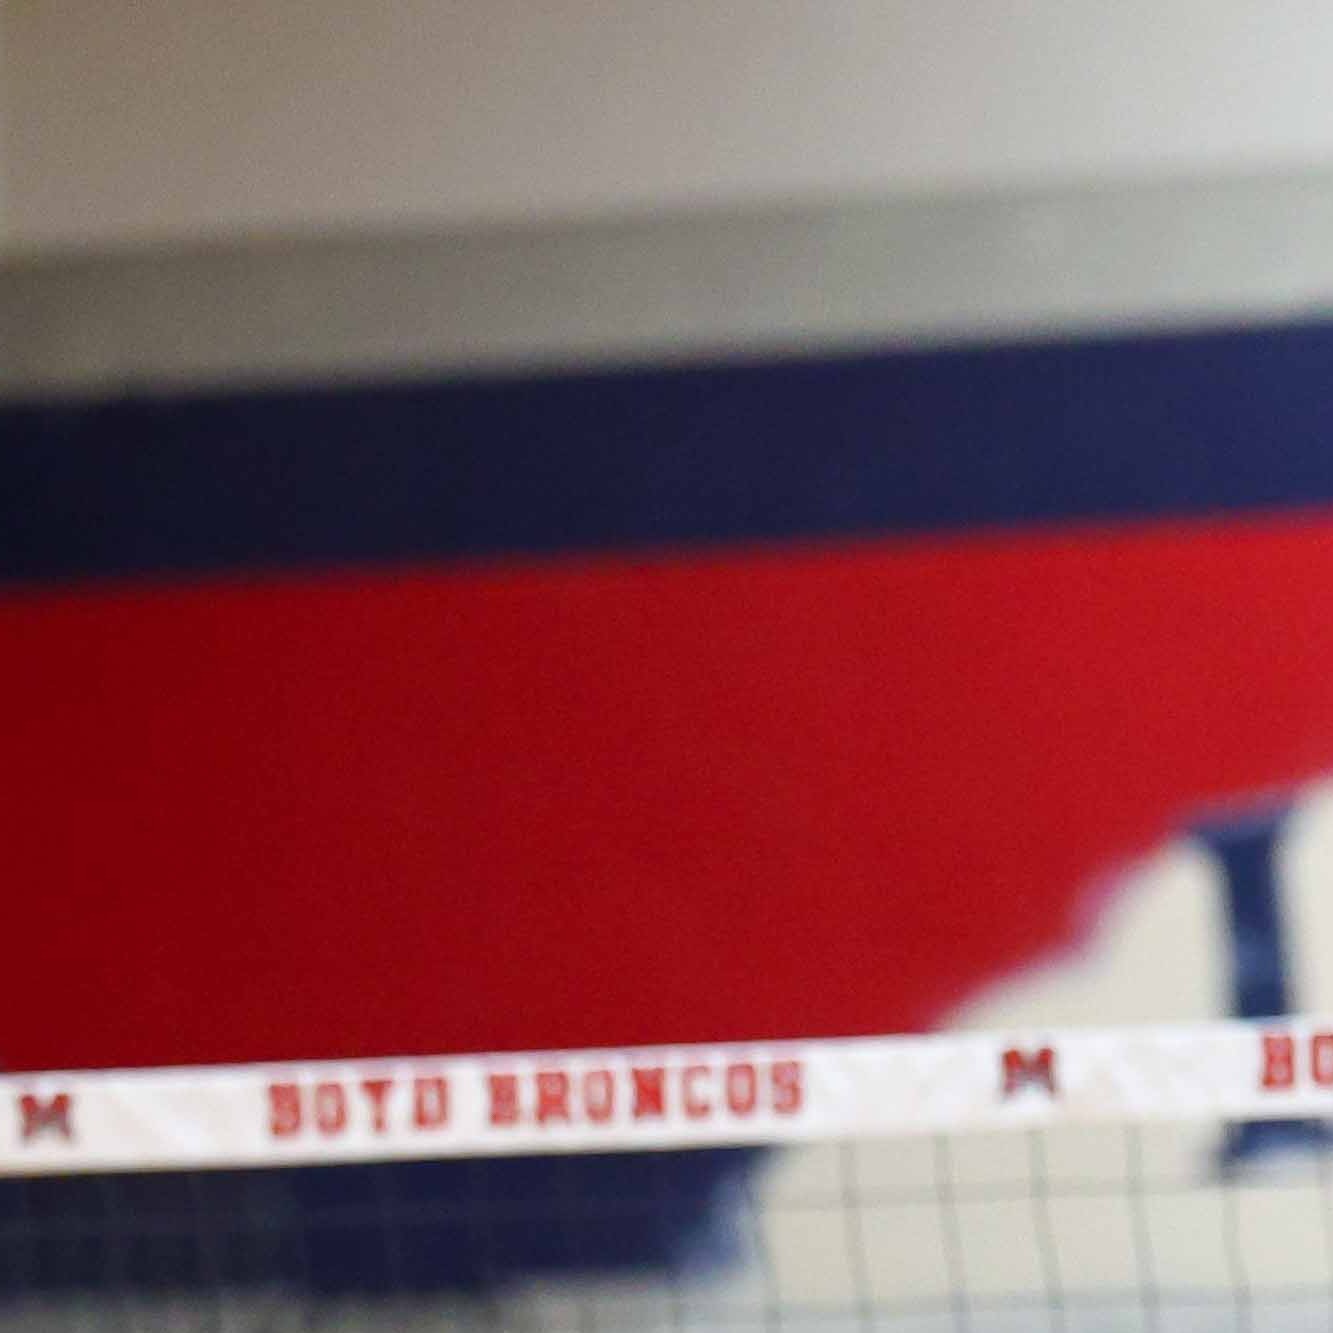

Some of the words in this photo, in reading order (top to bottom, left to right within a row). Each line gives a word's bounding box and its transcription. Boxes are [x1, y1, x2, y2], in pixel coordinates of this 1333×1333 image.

[267, 1075, 451, 1139] BOYD
[488, 1060, 803, 1128] BRONCOS
[1001, 1046, 1057, 1096] M
